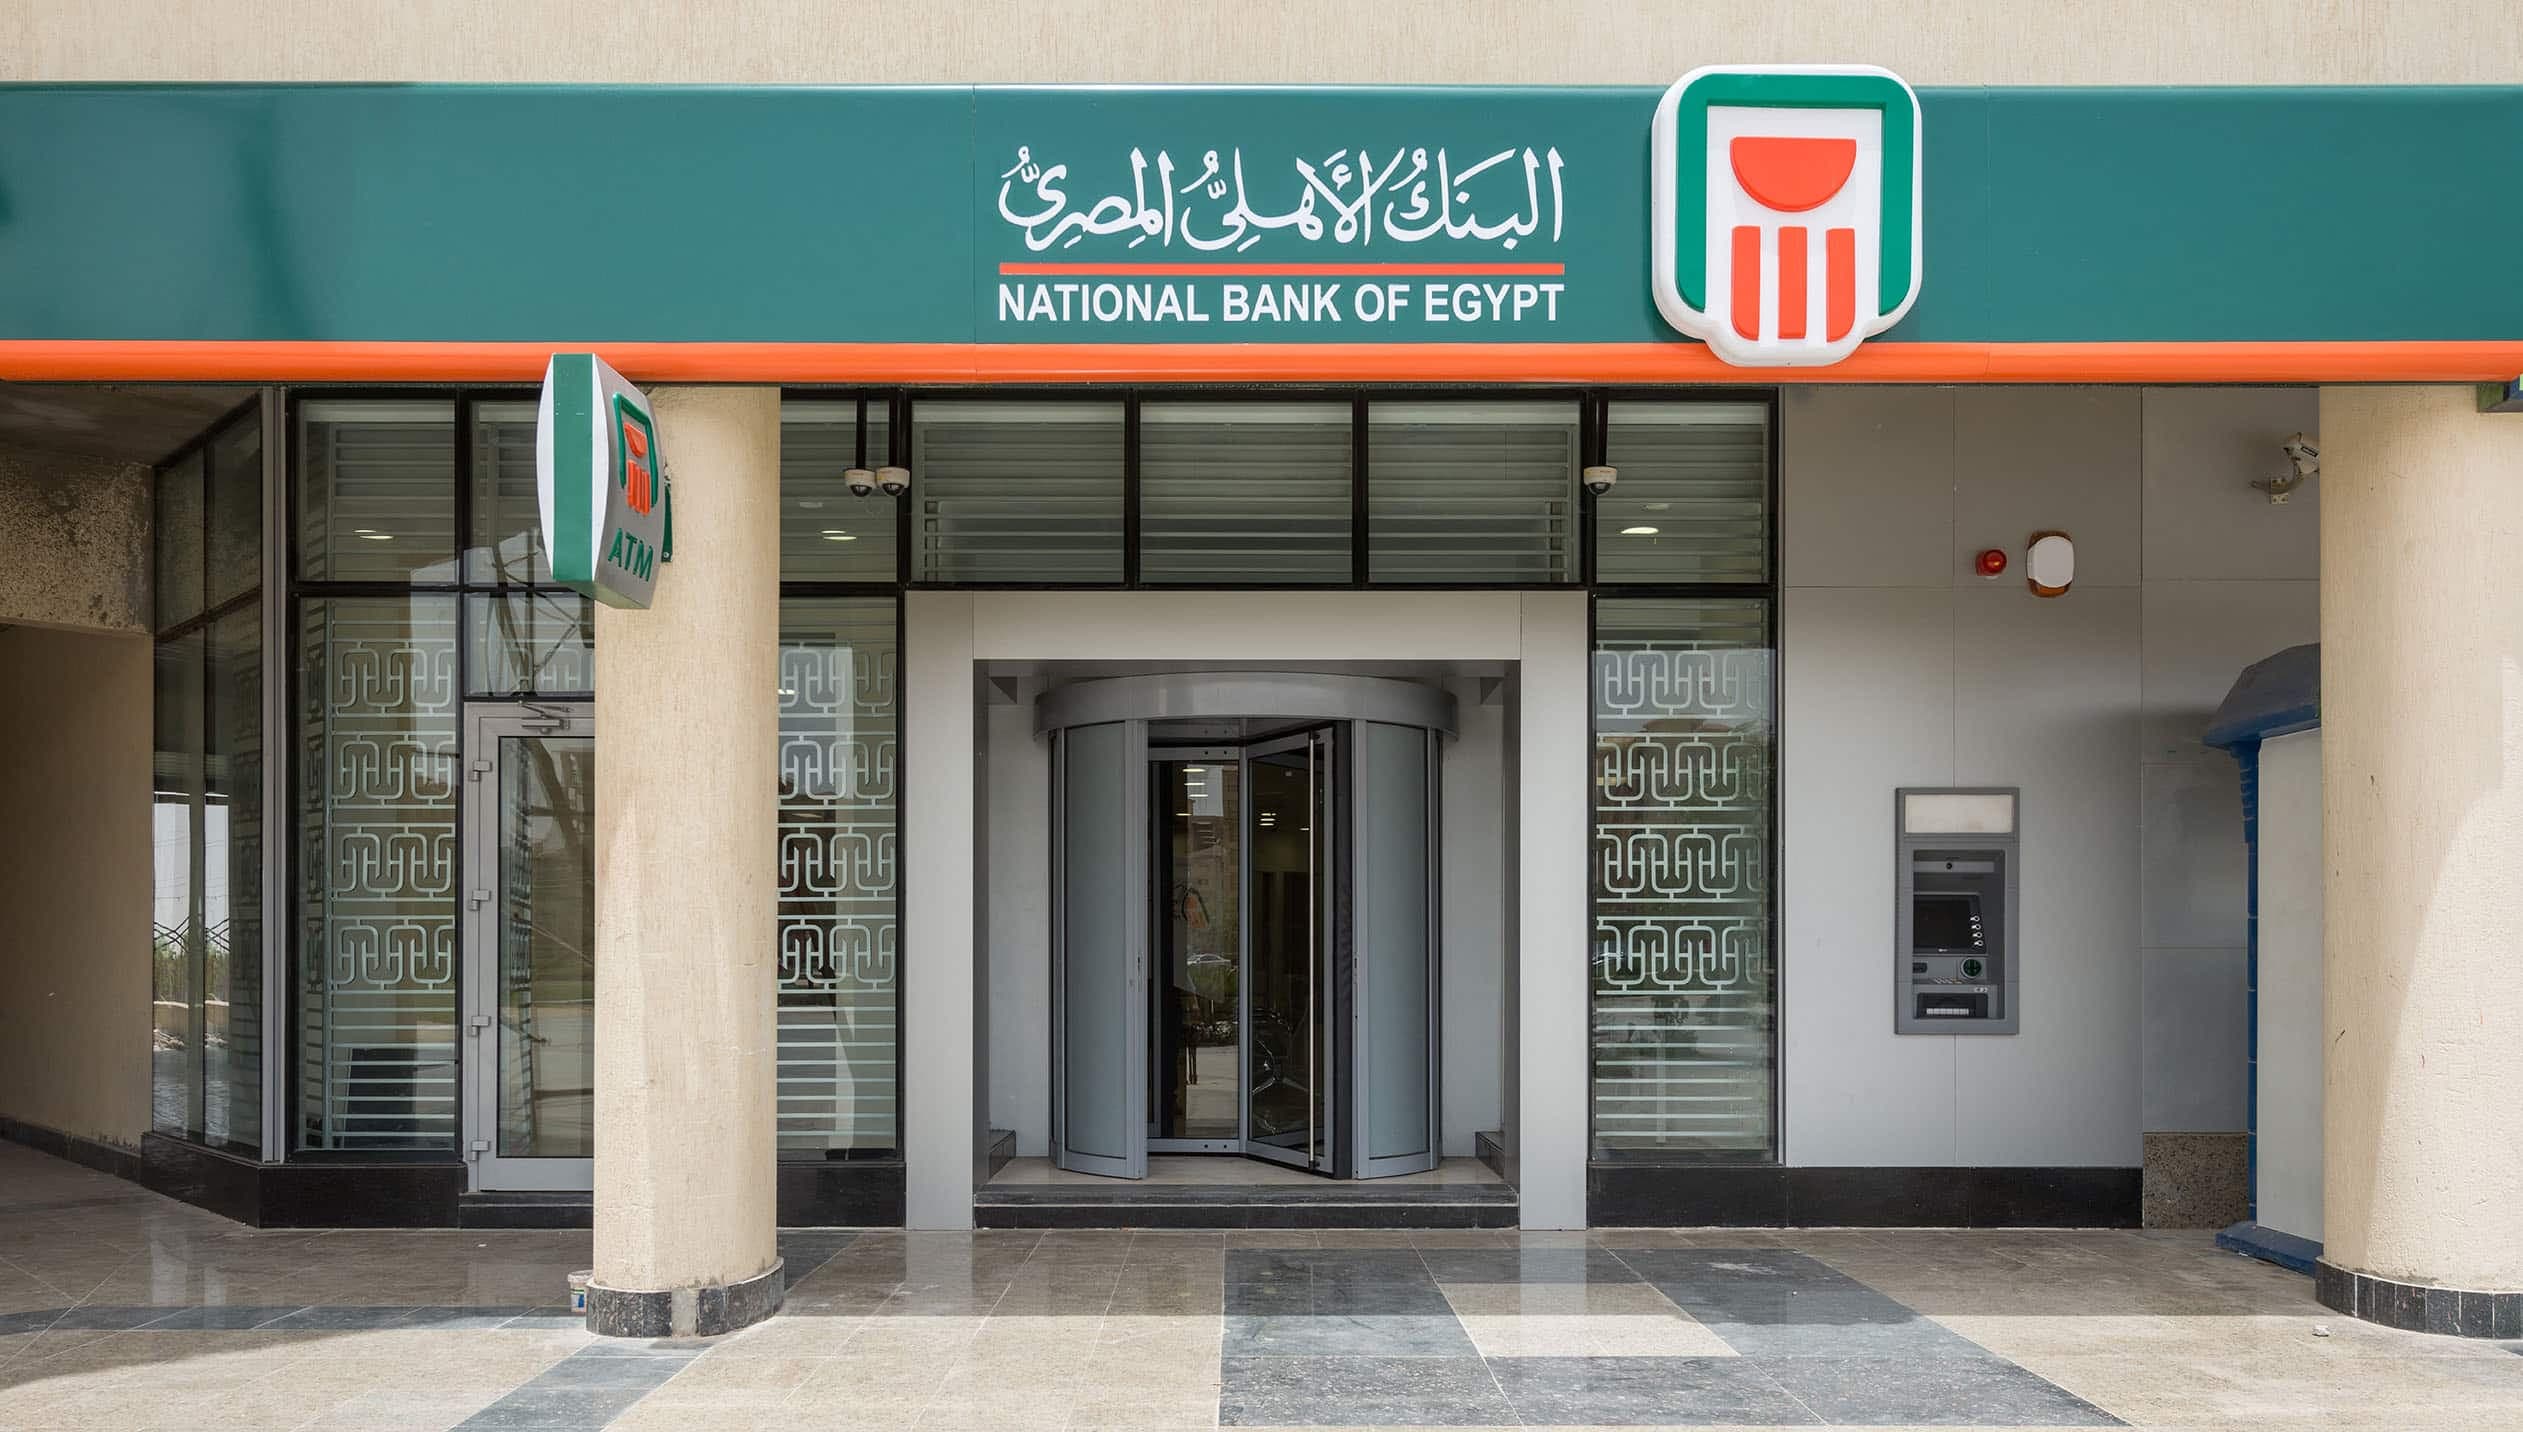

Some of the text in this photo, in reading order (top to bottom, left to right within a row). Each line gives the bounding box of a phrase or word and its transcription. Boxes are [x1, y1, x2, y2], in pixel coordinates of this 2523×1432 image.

[998, 283, 1566, 322] NATIONAL BANK OF EGYPT
[607, 526, 654, 583] ATM
